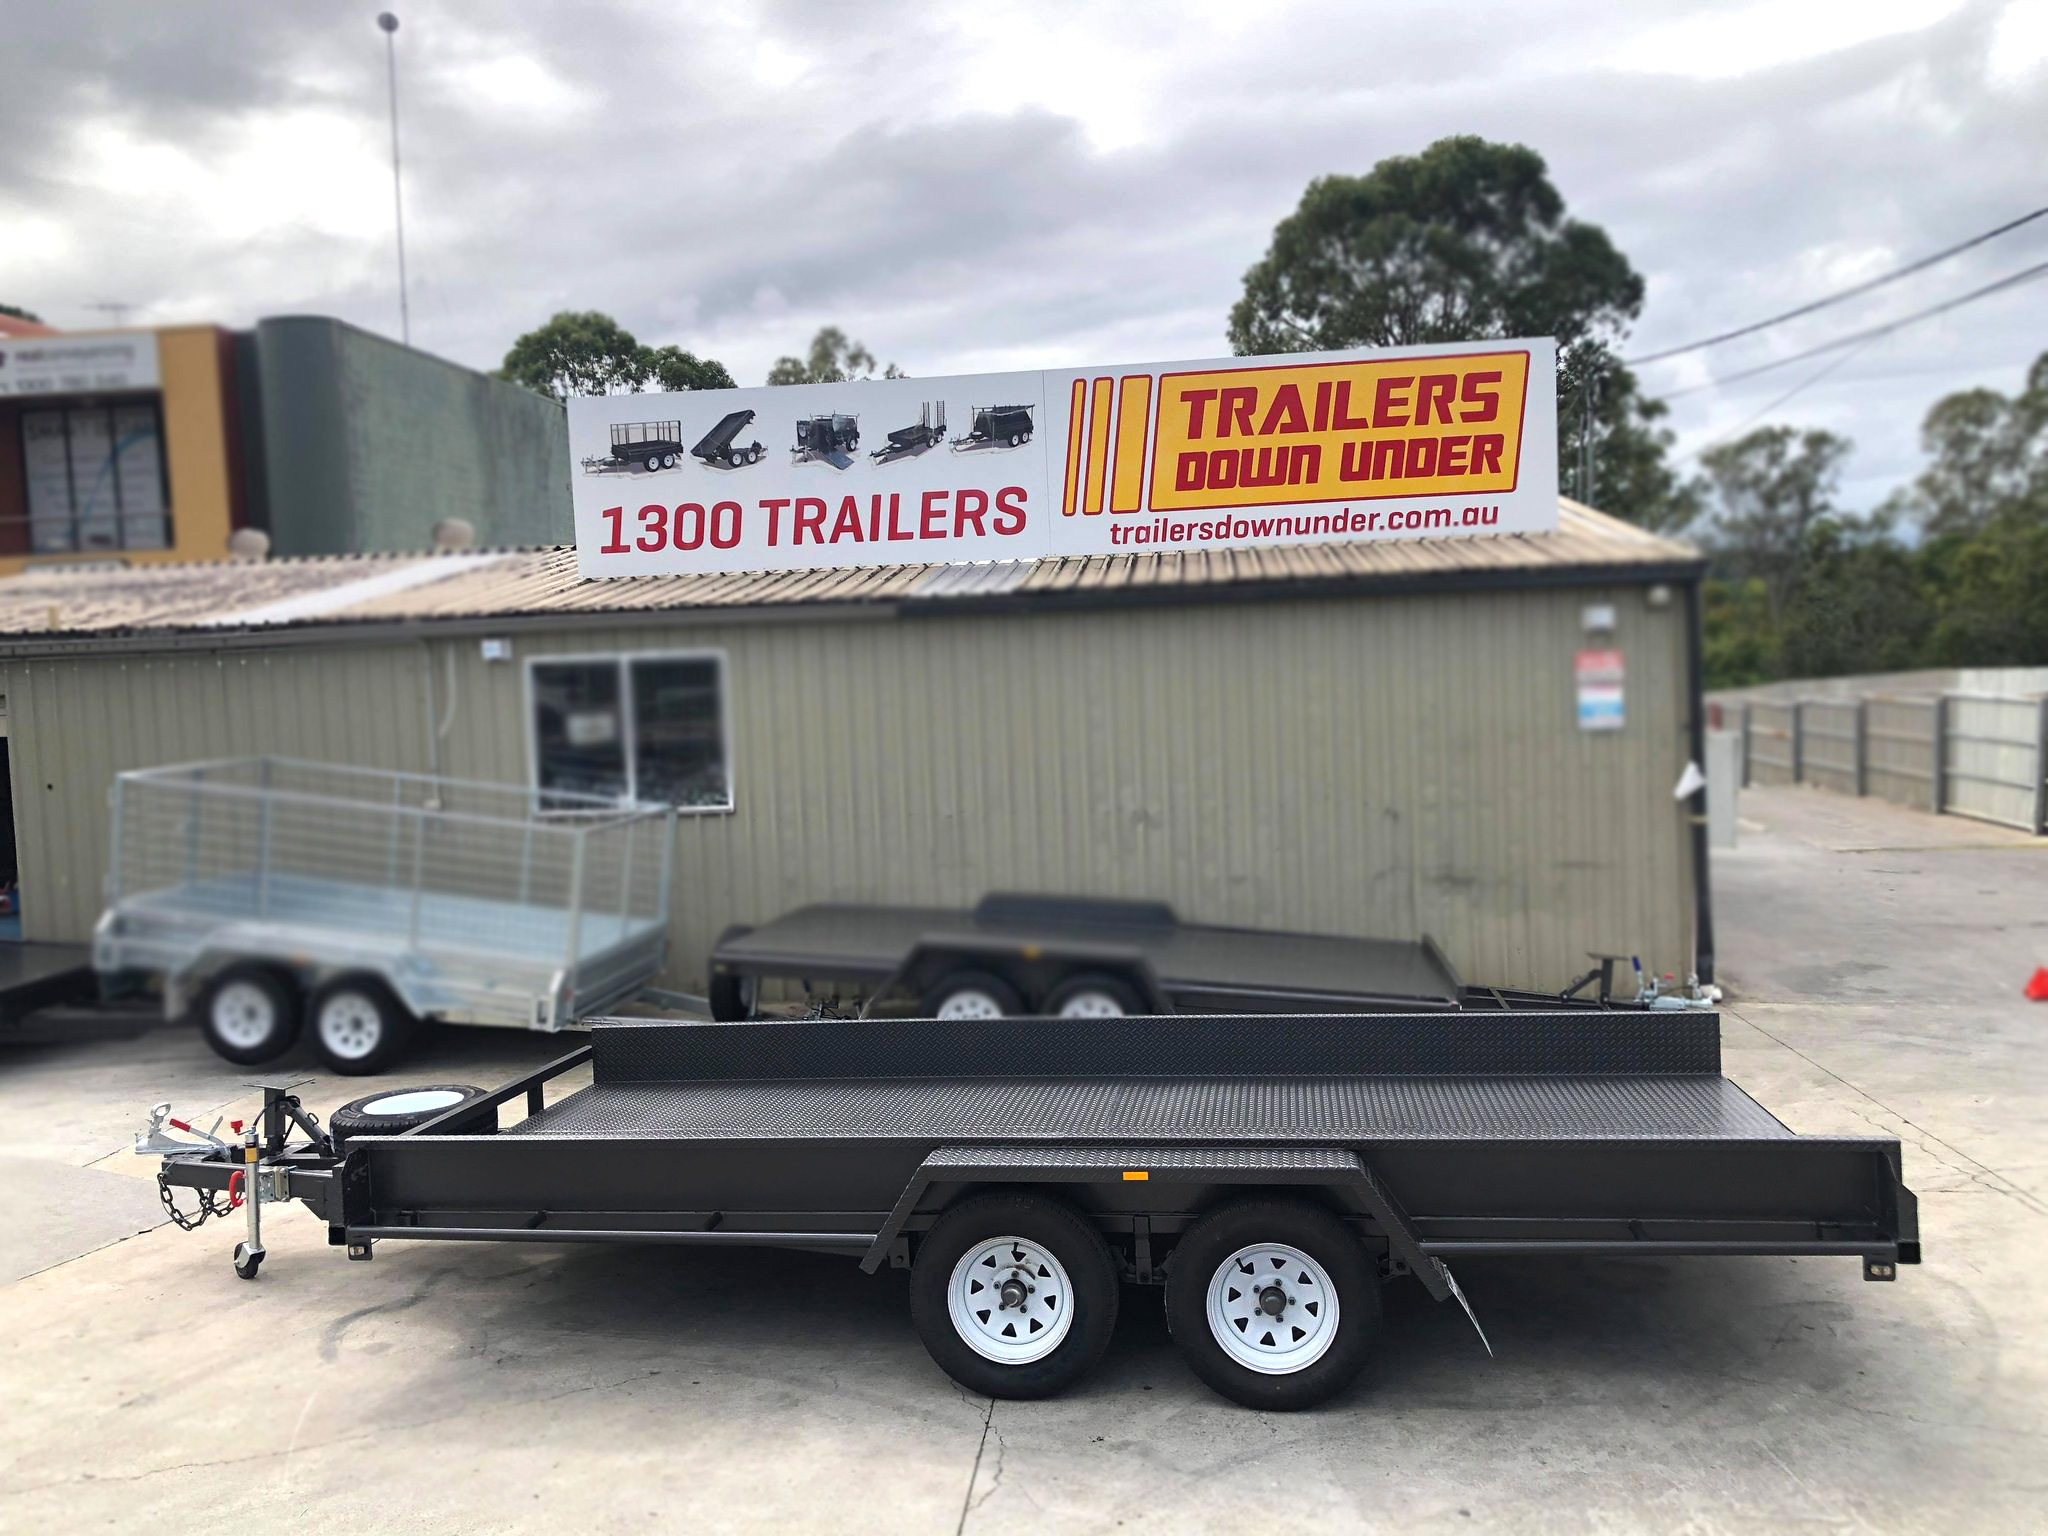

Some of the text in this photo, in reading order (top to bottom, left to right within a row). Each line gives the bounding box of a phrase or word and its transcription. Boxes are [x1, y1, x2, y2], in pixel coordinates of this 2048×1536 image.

[1179, 370, 1502, 440] TRAILERS
[1174, 433, 1505, 492] DOWN UNDER
[601, 486, 1029, 554] 1300 TRAILERS
[1110, 505, 1499, 545] trailersdownunder.com.au
